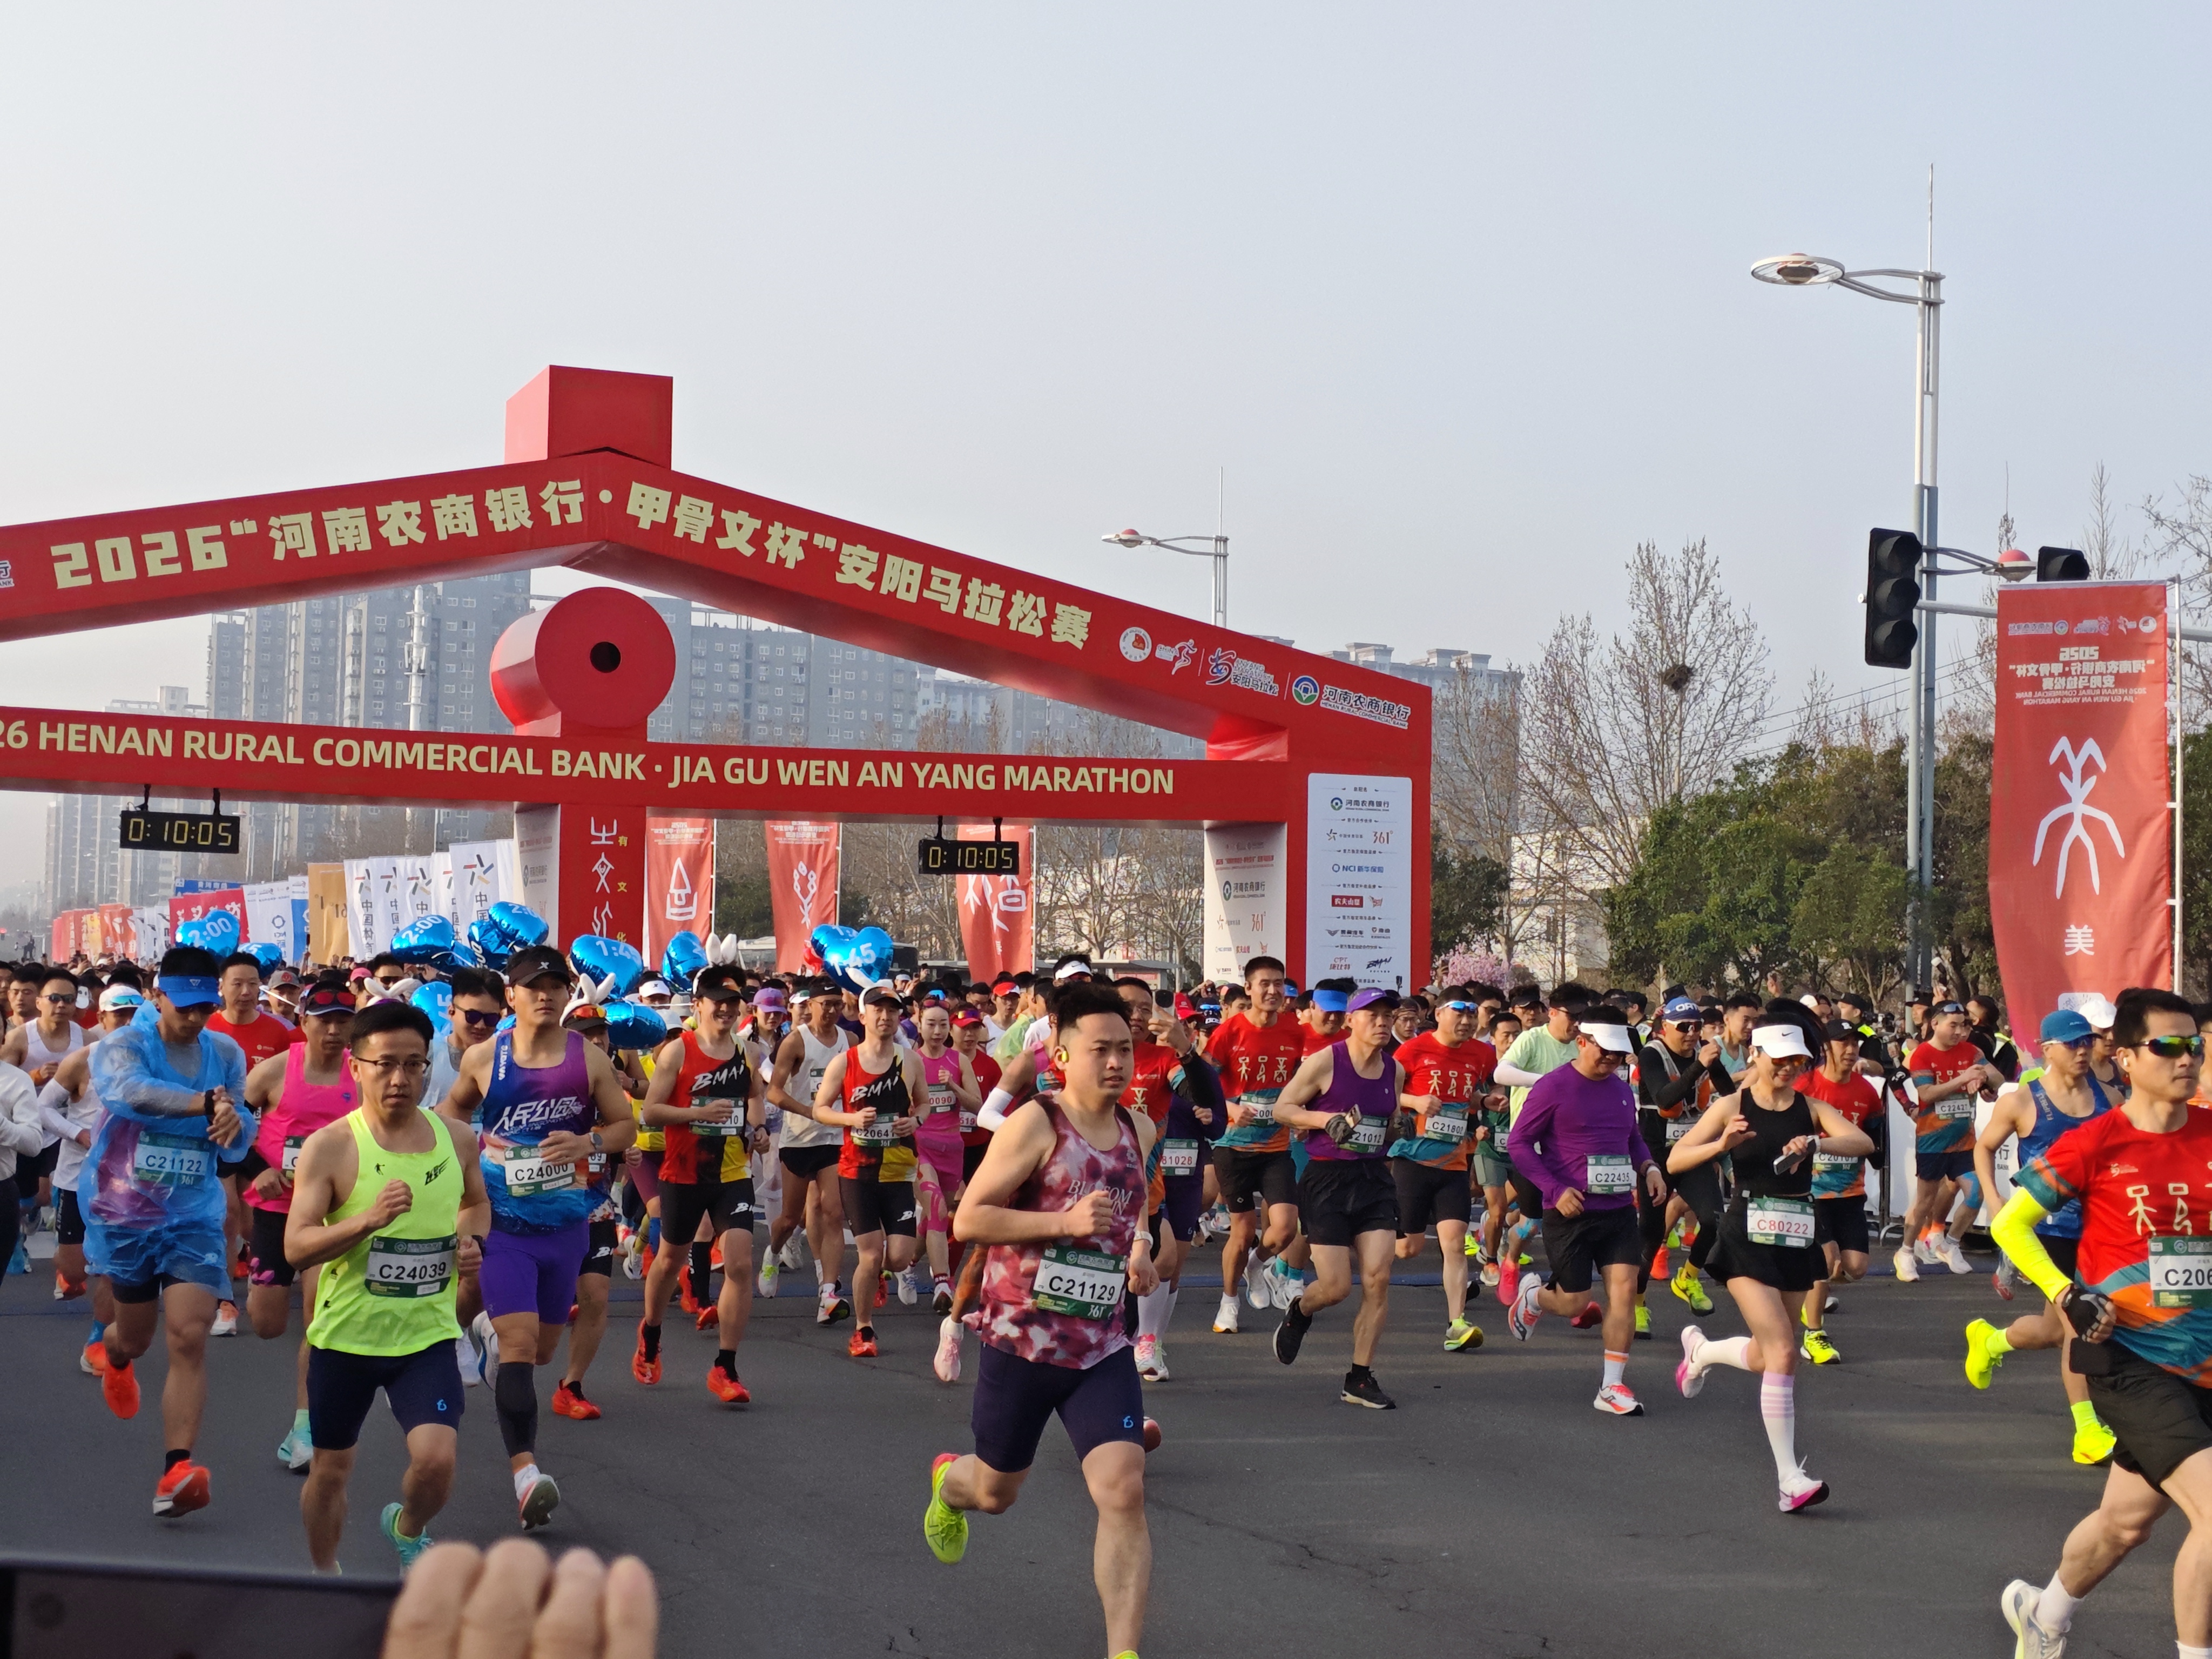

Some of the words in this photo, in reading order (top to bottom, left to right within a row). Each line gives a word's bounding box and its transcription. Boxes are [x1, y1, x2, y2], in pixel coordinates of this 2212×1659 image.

[1232, 675, 1278, 694] 安阳马拉松
[1323, 686, 1410, 720] 河南农商银行
[0, 720, 28, 748] 6
[39, 722, 172, 757] HENAN
[184, 731, 304, 764] RURAL
[313, 738, 542, 775] COMMERCIAL
[551, 750, 646, 780] BANK
[668, 756, 716, 788] JIA
[724, 758, 768, 785] GU
[777, 759, 849, 786] WEN
[857, 761, 903, 788] AN
[911, 763, 995, 791] YANG
[1004, 765, 1174, 794] MARATHON
[1345, 799, 1390, 808] 河南农商银行
[617, 882, 627, 892] 文
[188, 918, 232, 948] 2:00
[401, 917, 442, 944] 2:00
[1352, 1131, 1381, 1144] 21012
[145, 1155, 203, 1174] C21122
[1595, 1172, 1630, 1183] C22435
[1757, 1219, 1809, 1236] C80222
[379, 1262, 447, 1282] C24039
[1049, 1276, 1116, 1302] C21129
